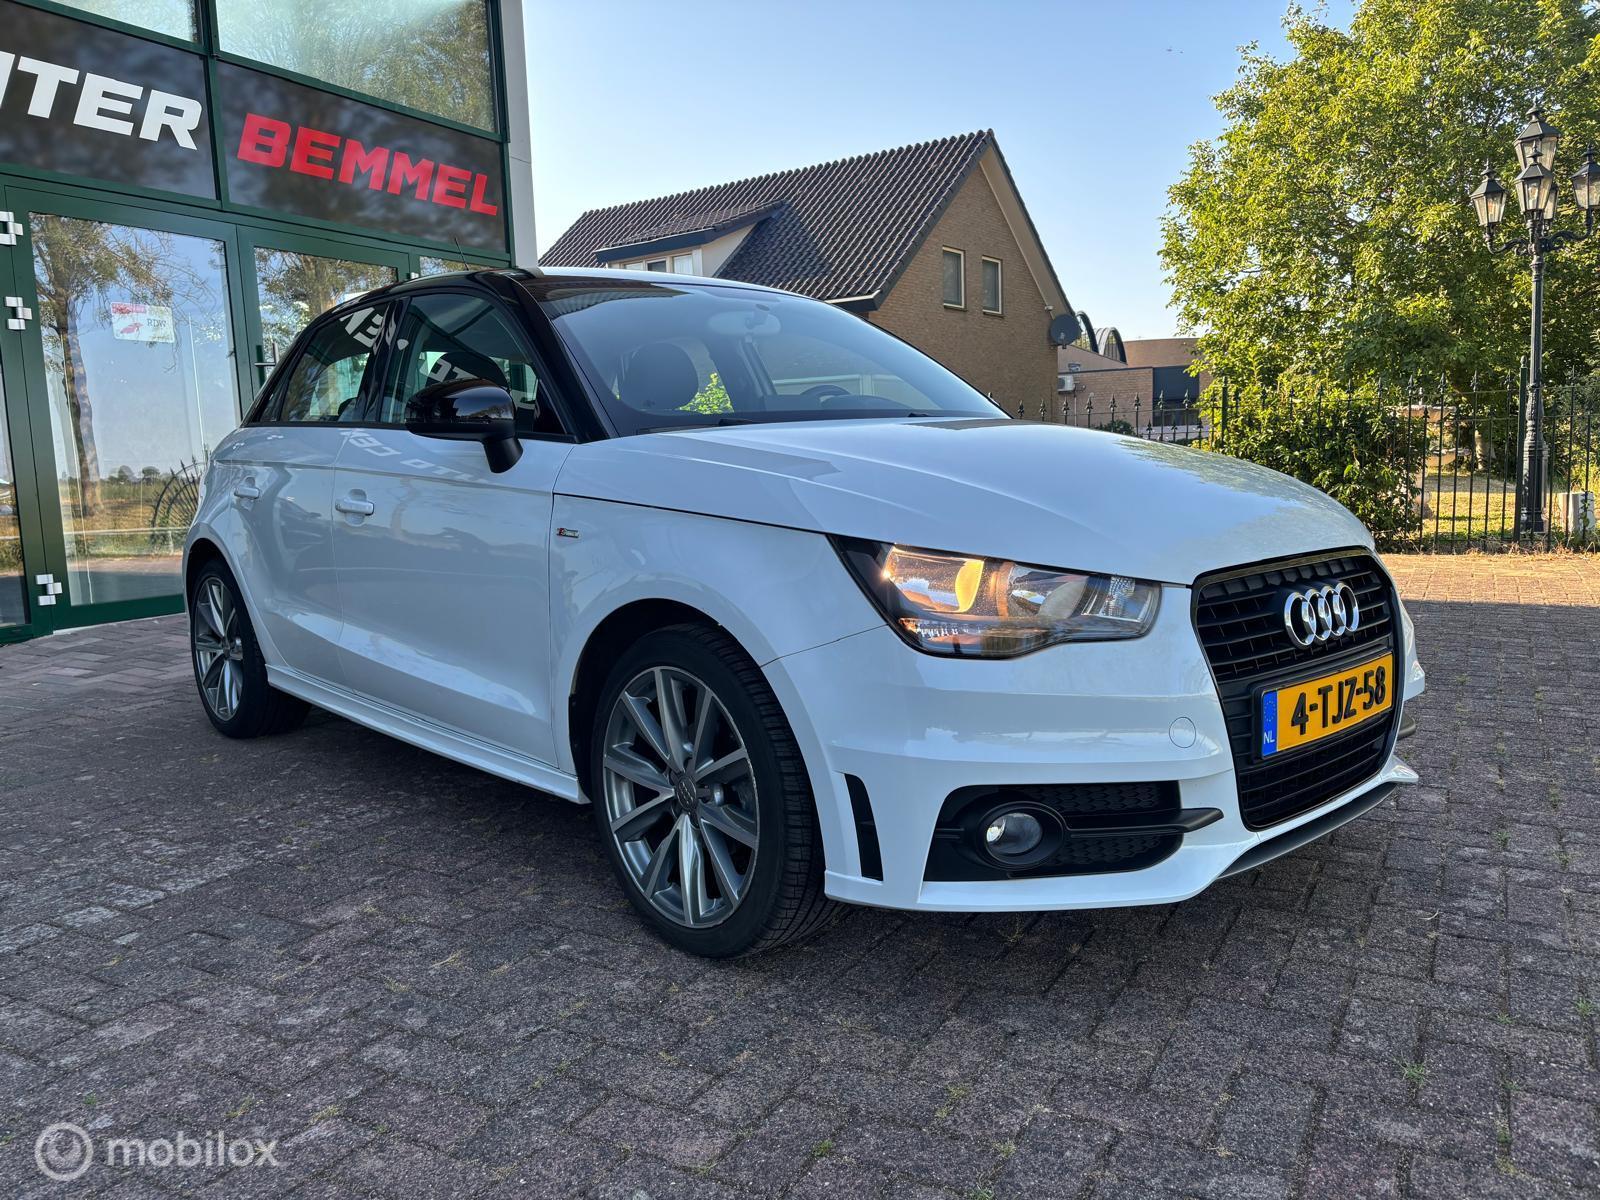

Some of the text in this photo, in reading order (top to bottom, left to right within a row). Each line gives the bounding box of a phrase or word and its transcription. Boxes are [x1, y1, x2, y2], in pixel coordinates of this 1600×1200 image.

[0, 51, 202, 150] TER
[237, 112, 499, 216] BEMMEL
[1263, 731, 1275, 745] NL
[1291, 665, 1386, 735] 4-TJZ-58
